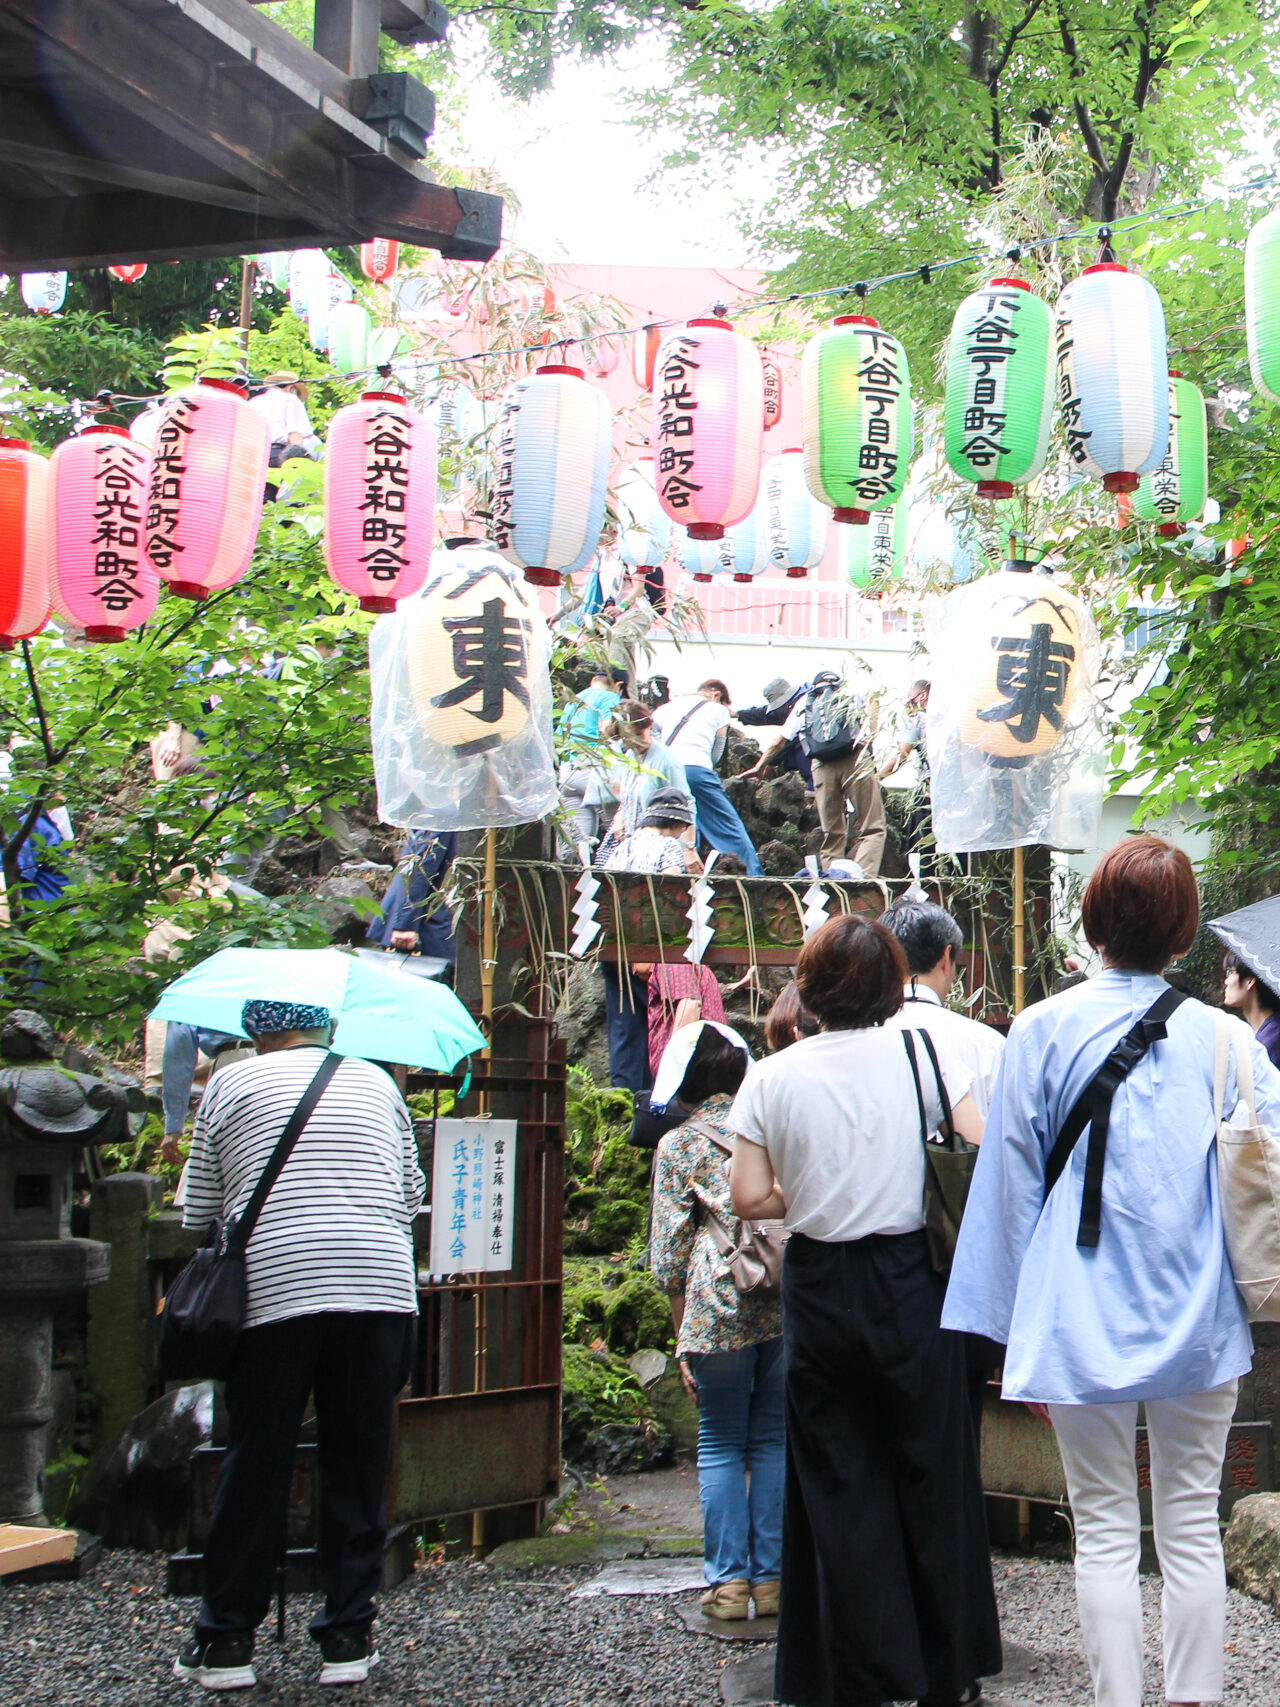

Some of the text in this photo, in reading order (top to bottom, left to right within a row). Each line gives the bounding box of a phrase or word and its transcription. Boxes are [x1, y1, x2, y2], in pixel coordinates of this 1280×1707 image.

[848, 330, 902, 499] 下谷一丁目町会
[960, 292, 1018, 467] 下谷一丁目町会
[430, 597, 533, 723] 東
[976, 623, 1075, 743] 東
[449, 1140, 468, 1258] 氏子青年会
[472, 1133, 485, 1220] 小野照崎神社
[490, 1139, 506, 1255] 富士塚 清掃奉仕
